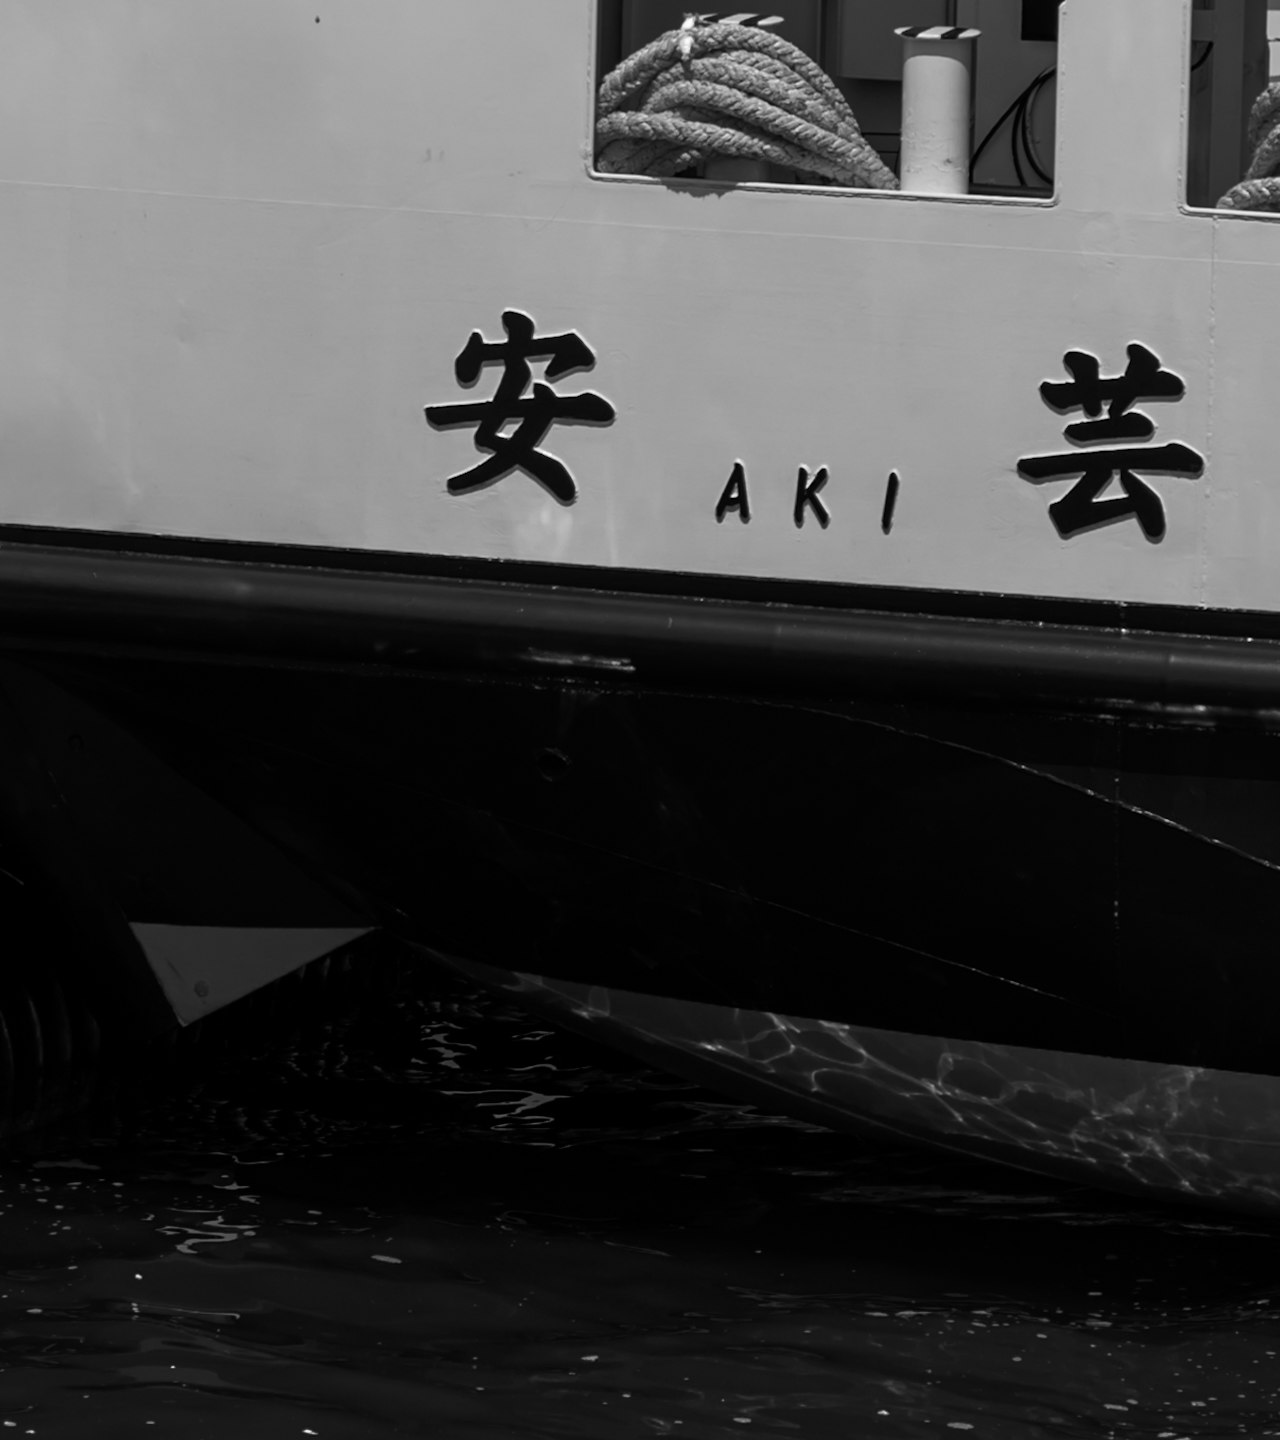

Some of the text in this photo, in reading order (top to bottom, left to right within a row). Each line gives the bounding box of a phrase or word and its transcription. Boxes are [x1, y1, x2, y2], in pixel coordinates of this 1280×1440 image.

[423, 310, 615, 506] 安
[715, 462, 899, 534] AKI
[1016, 343, 1204, 544] 芸
